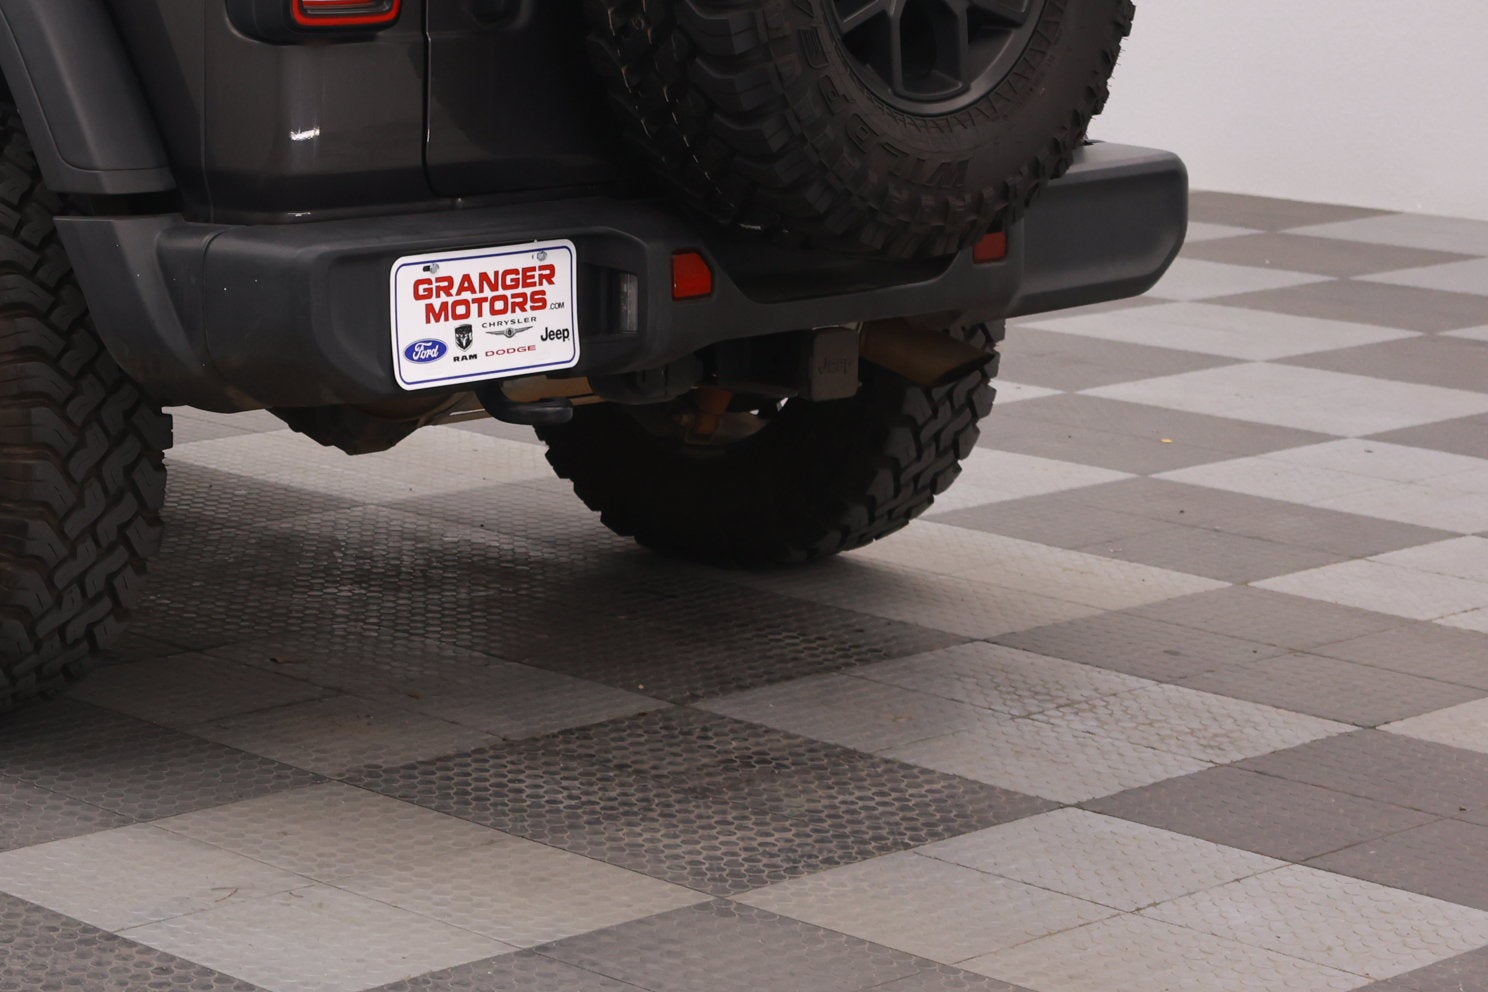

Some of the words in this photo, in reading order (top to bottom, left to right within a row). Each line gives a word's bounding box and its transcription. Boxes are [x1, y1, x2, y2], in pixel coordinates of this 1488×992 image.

[413, 264, 556, 301] GRANGER
[425, 289, 547, 325] MOTORS
[481, 316, 537, 329] CHRYSLER
[540, 327, 570, 343] Jeep
[412, 341, 439, 360] Ford
[453, 354, 478, 362] RAM
[485, 344, 537, 357] DODGE
